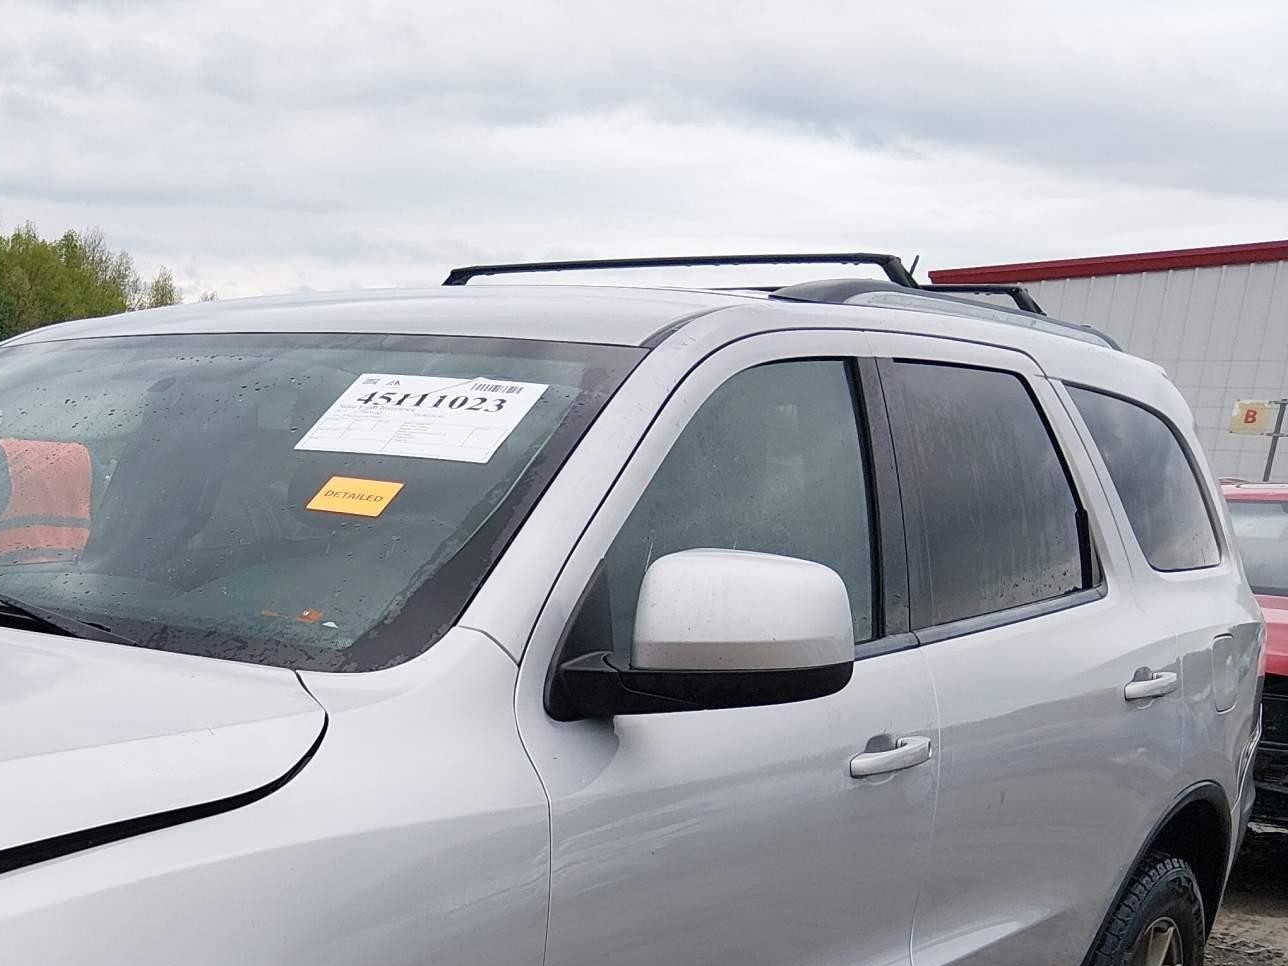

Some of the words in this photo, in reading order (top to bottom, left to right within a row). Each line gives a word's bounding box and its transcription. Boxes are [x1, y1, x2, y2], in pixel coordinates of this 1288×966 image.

[357, 391, 508, 413] 45111023
[1244, 410, 1258, 424] B
[324, 490, 383, 503] DETAILED
